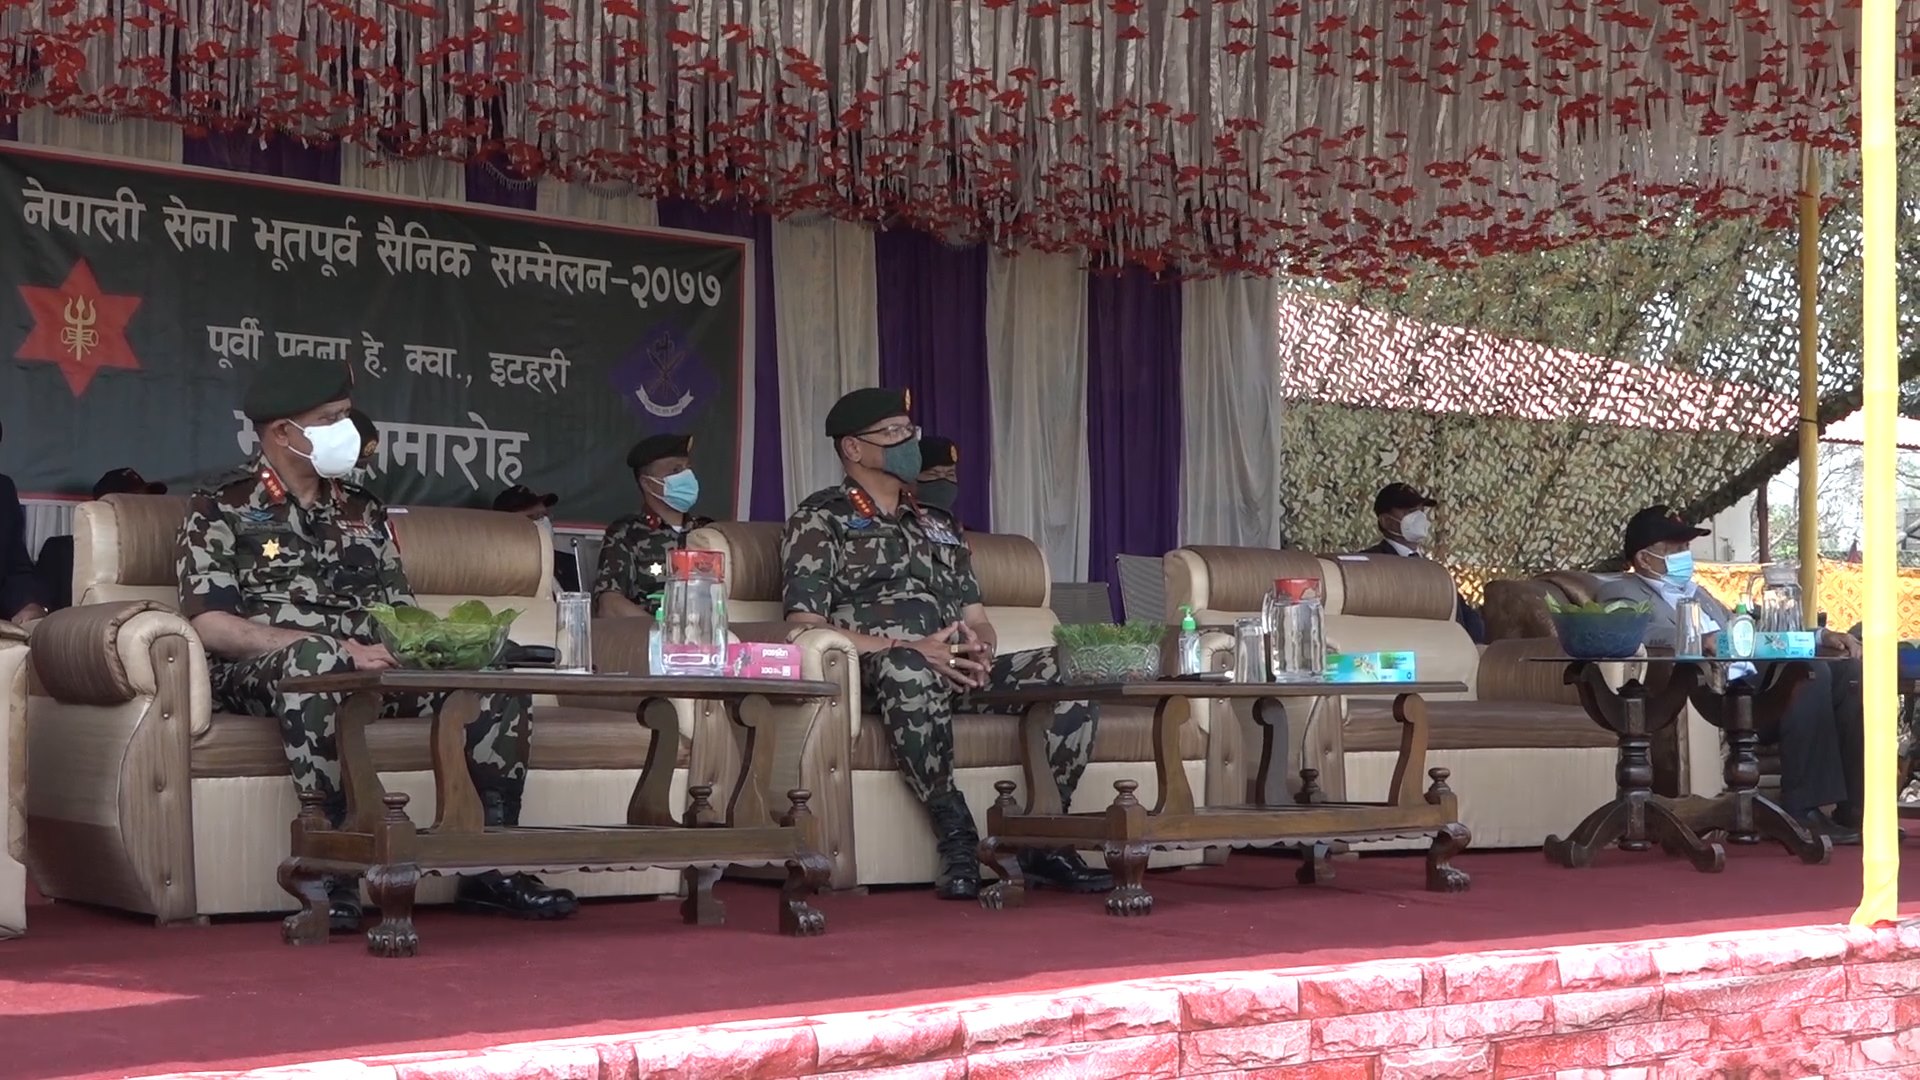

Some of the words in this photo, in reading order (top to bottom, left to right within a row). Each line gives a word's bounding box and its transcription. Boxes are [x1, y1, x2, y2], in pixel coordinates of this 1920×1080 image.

[22, 176, 147, 243] नेपाली
[162, 195, 238, 252] सेना
[251, 215, 362, 277] भूतपूर्व
[375, 215, 477, 279] सैनिक
[206, 316, 264, 369] पूर्वी
[361, 330, 388, 379] हे.
[489, 347, 571, 394] इटहरी
